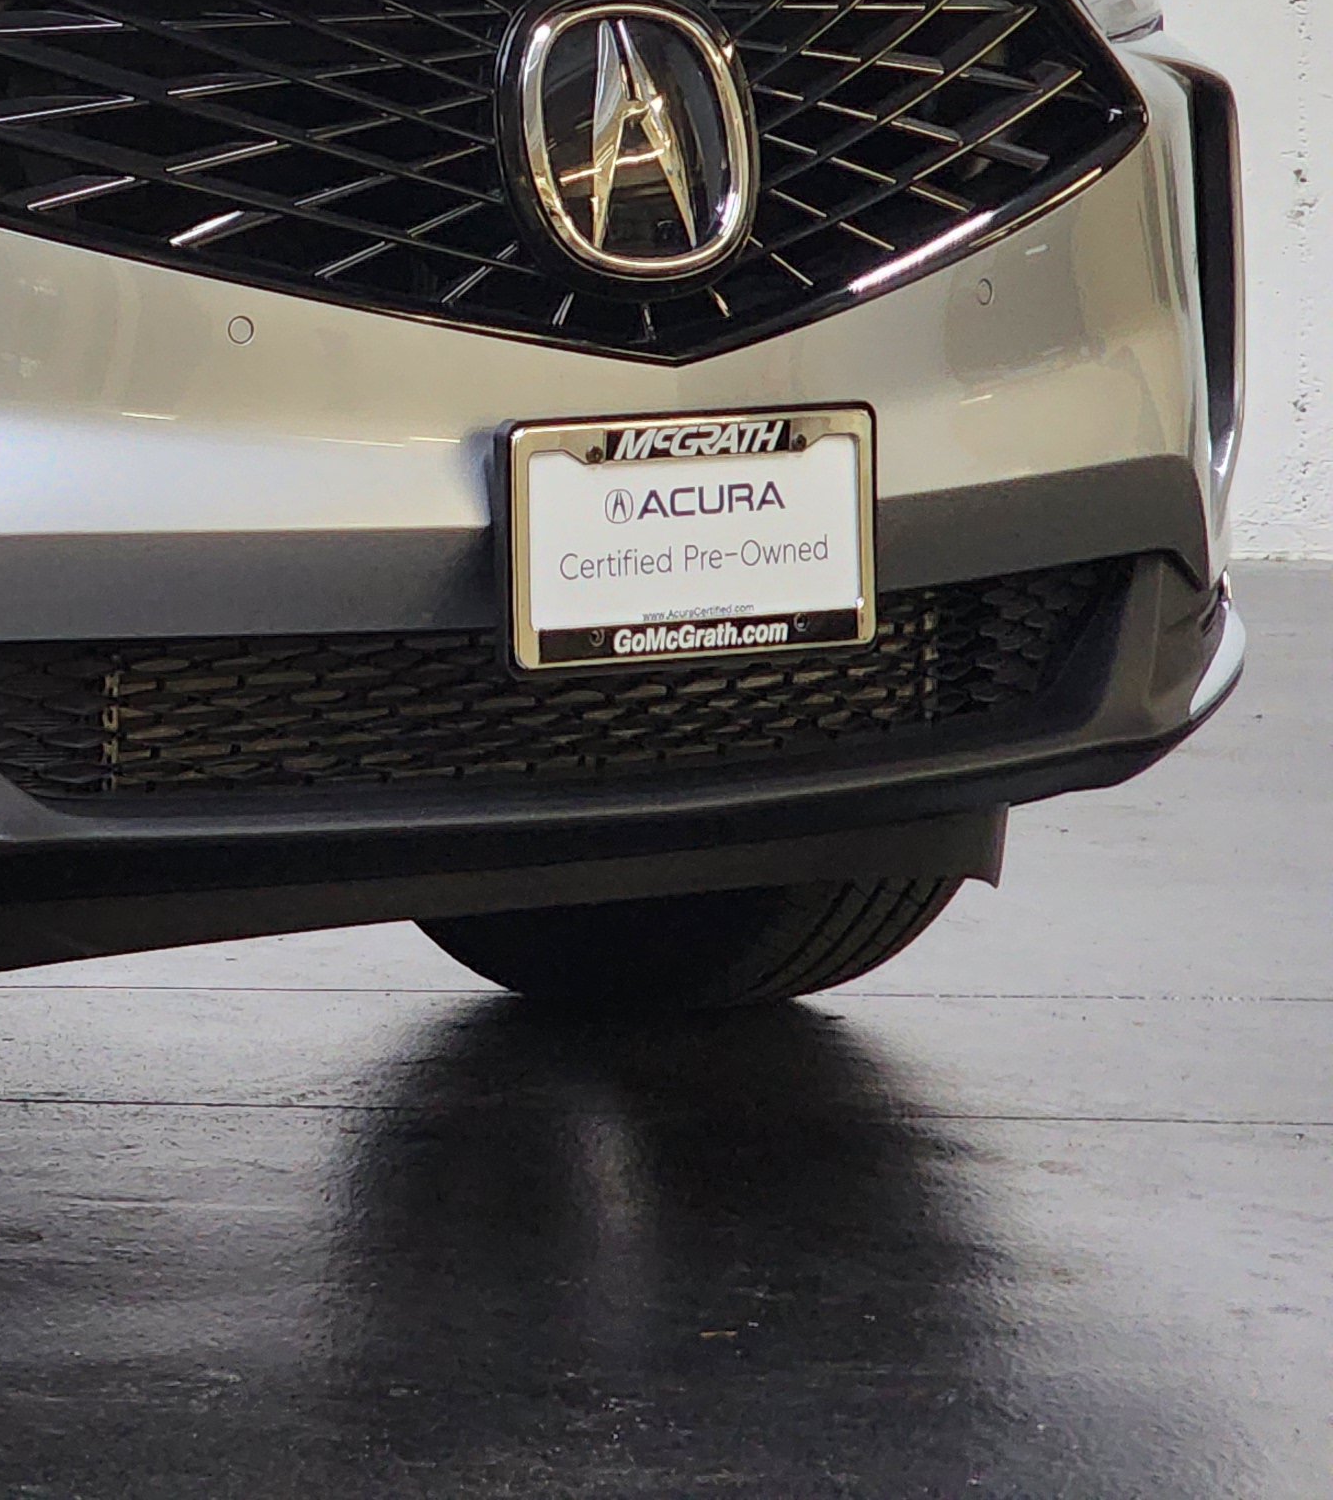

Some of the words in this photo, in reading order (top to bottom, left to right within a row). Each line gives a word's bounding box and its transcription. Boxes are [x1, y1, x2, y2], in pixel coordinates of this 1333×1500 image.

[614, 421, 784, 460] McGRATH
[637, 481, 786, 519] ACURA
[559, 546, 673, 581] Certified
[684, 534, 828, 572] Pre-Owned
[642, 603, 755, 621] www.AcuraCertified.com
[614, 621, 788, 654] GoMcGrath.com
